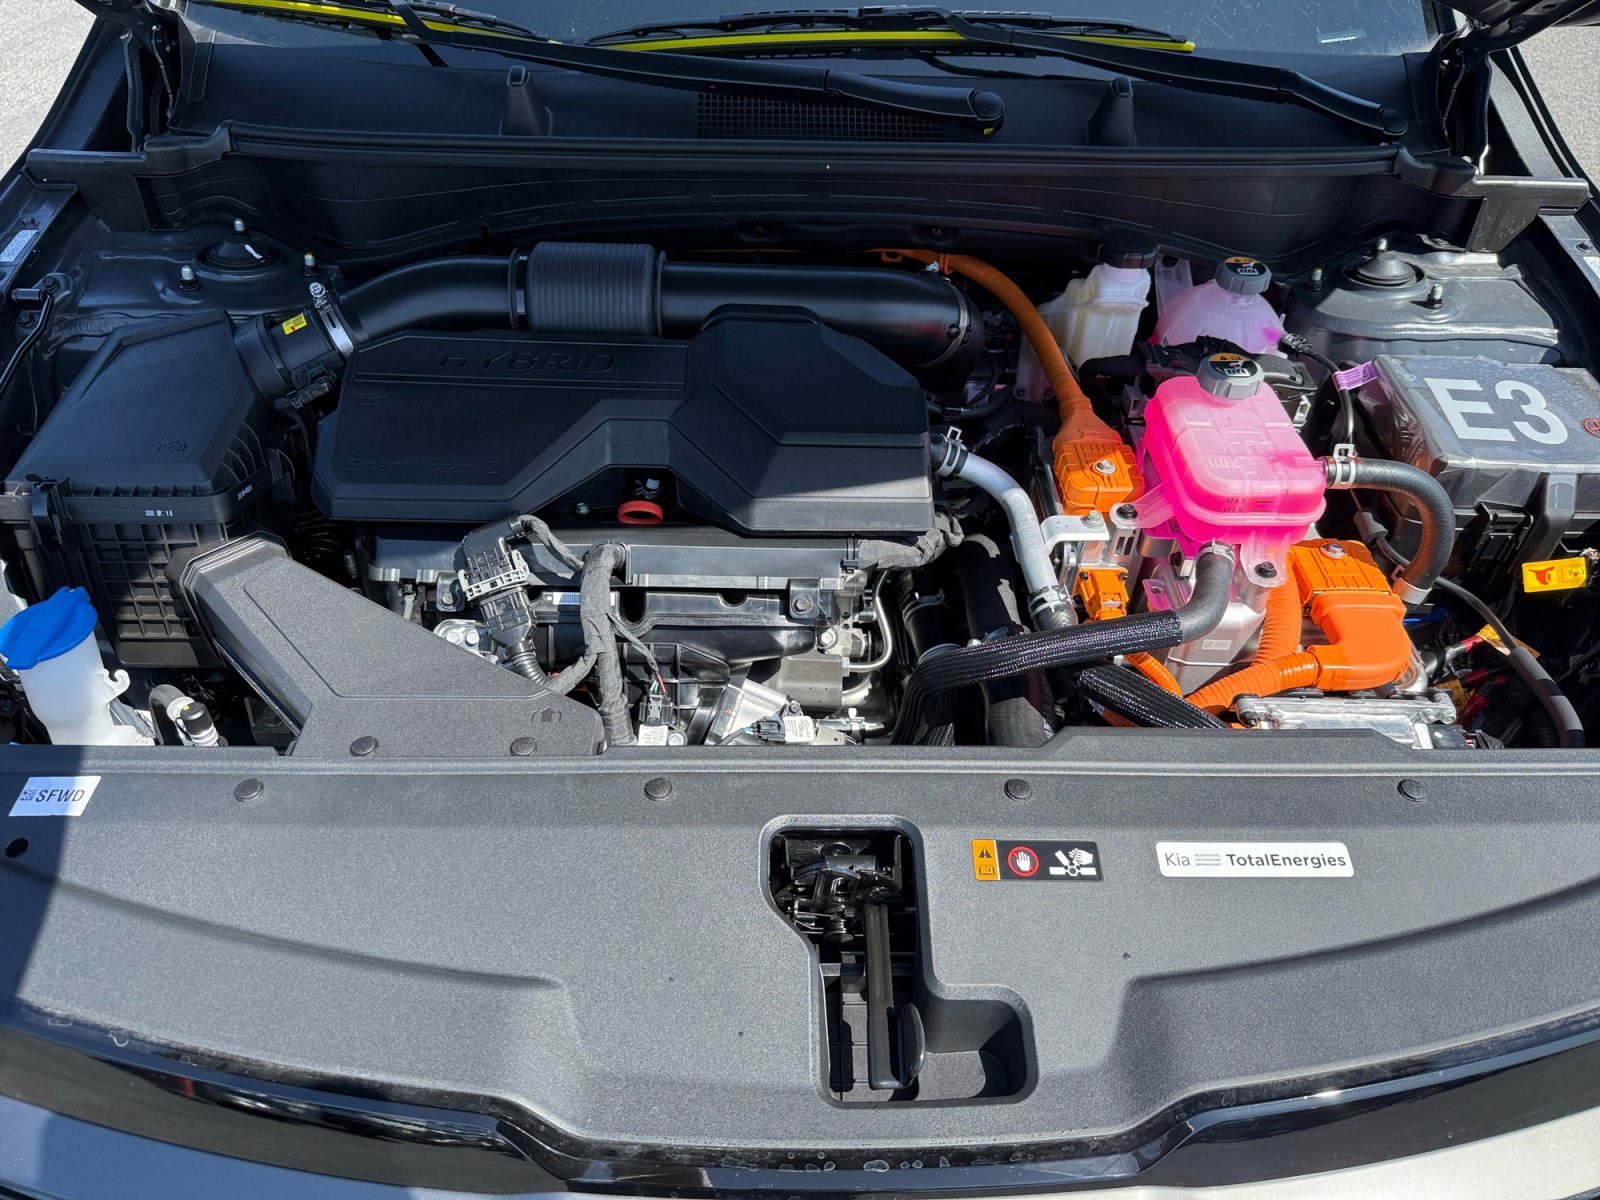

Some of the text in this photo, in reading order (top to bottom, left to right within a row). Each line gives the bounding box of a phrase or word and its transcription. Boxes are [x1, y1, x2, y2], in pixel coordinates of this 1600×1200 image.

[437, 350, 617, 374] HYBRID
[1423, 377, 1569, 445] E3
[35, 789, 85, 803] SFWD
[1164, 852, 1347, 869] Kia TotalEnergies
